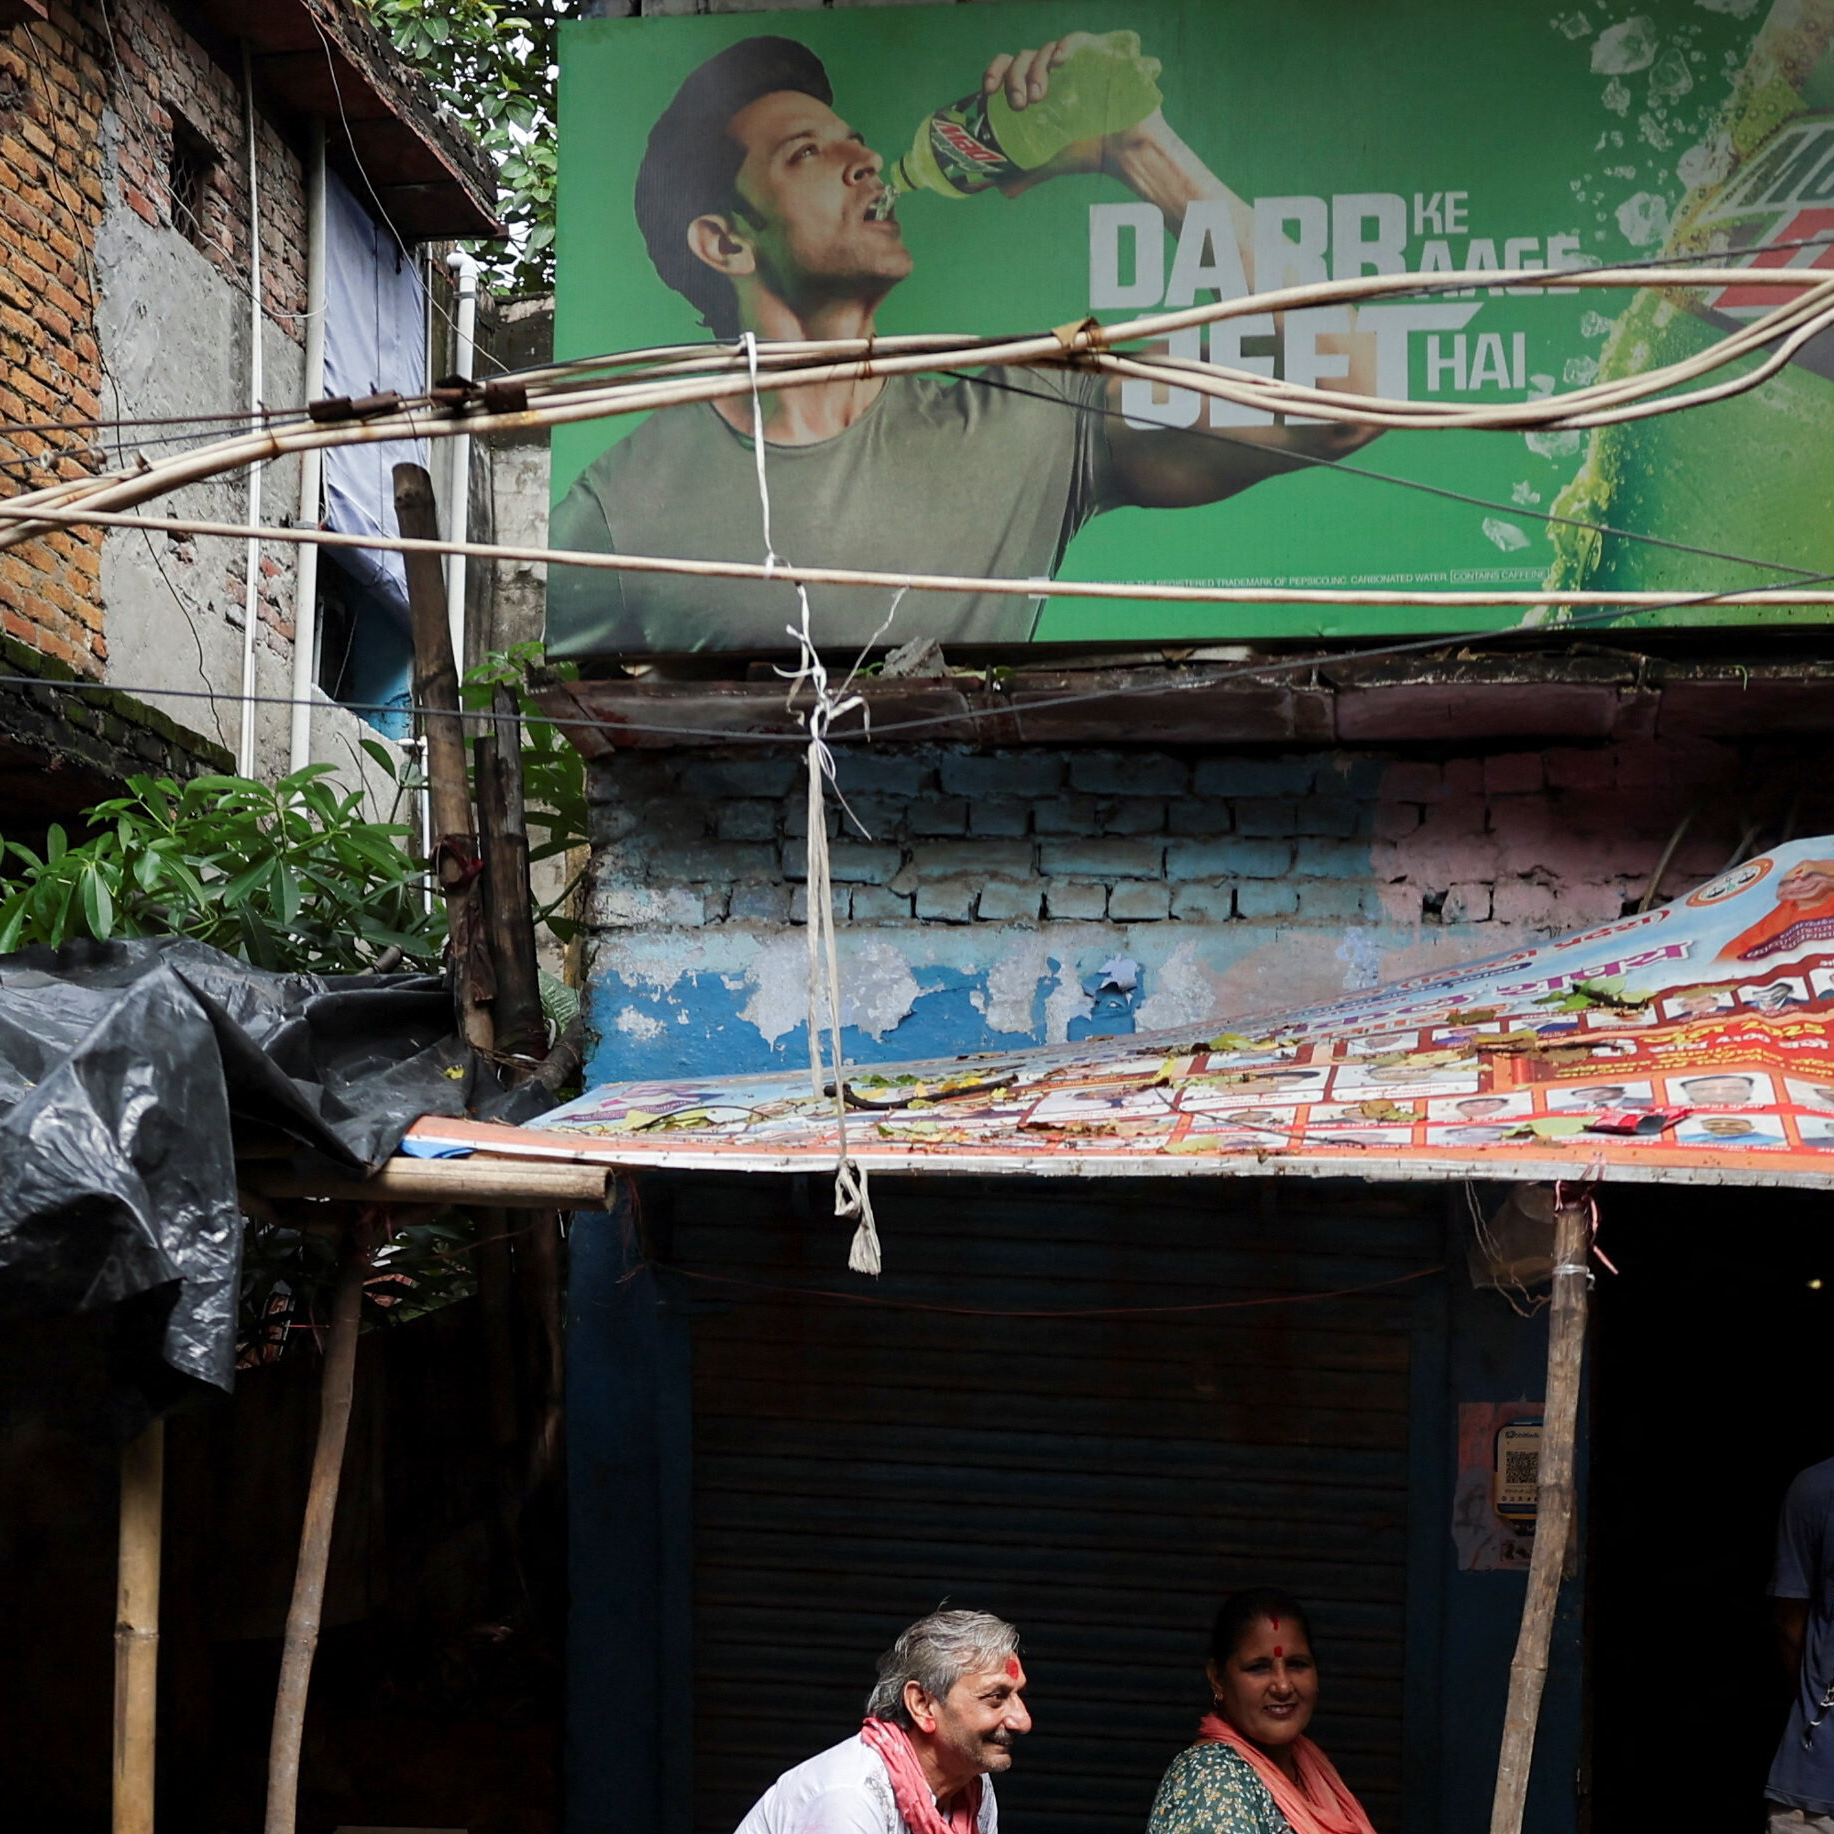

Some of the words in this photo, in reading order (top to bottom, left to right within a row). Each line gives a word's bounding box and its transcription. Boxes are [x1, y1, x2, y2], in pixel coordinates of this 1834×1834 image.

[1414, 191, 1468, 235] KE
[1089, 192, 1407, 310] DARR
[1415, 236, 1581, 298] AAGE
[1121, 302, 1484, 431] JEET
[1427, 332, 1526, 392] HAI
[1217, 577, 1272, 588] TRADEMARK
[1274, 576, 1286, 587] OF
